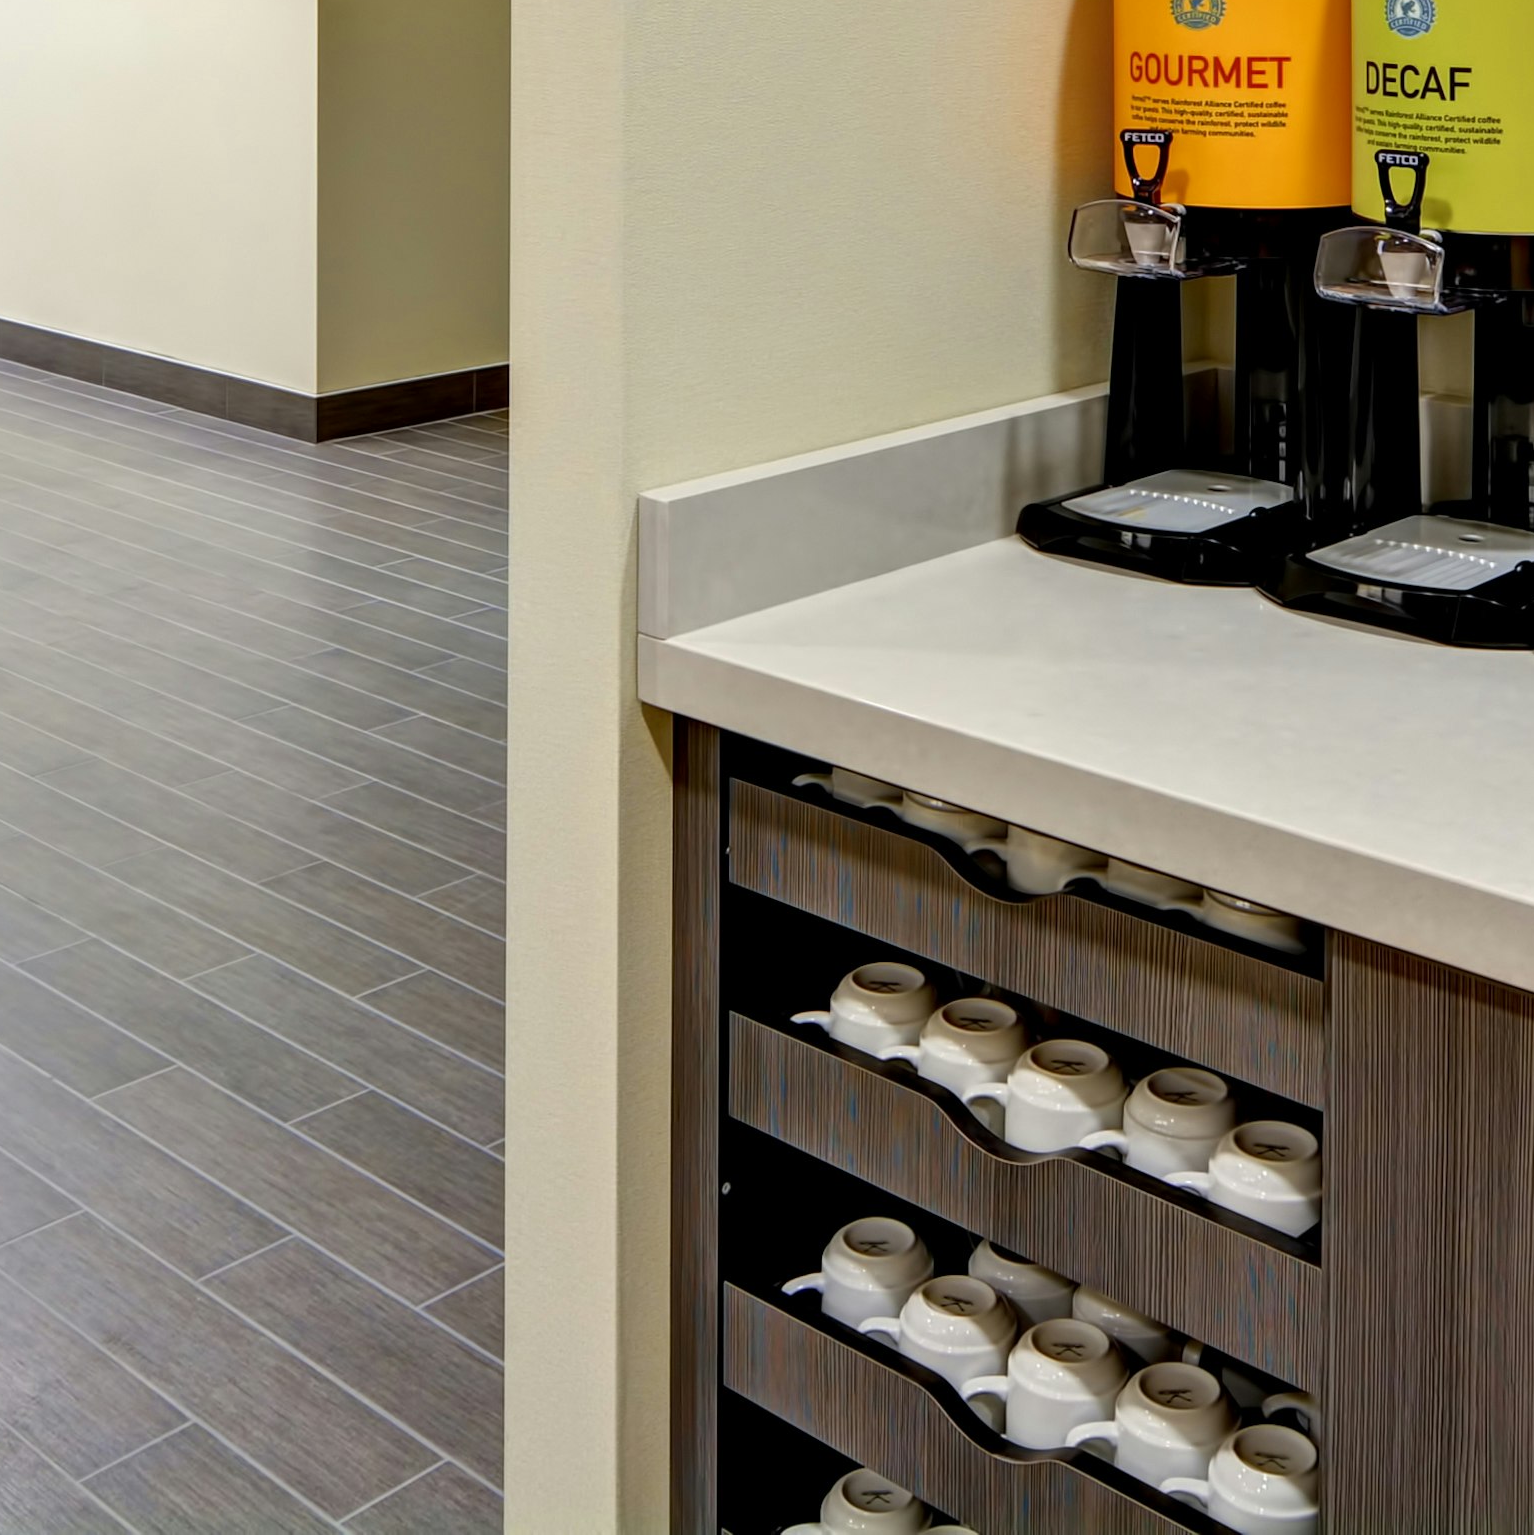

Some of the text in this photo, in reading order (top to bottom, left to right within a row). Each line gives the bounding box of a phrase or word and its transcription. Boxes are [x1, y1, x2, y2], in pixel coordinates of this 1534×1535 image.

[1129, 51, 1292, 89] GOURMET
[1366, 60, 1472, 102] DECAF
[1205, 100, 1232, 108] Alliance
[1247, 110, 1289, 118] sustainable
[1415, 113, 1443, 121] Alliance
[1444, 114, 1476, 123] Certified
[1477, 116, 1501, 124] coffee
[1234, 121, 1259, 129] protect
[1458, 126, 1504, 134] sustainable
[1123, 131, 1166, 144] FETCO
[1472, 137, 1501, 145] wildlife
[1378, 152, 1419, 166] FETCO
